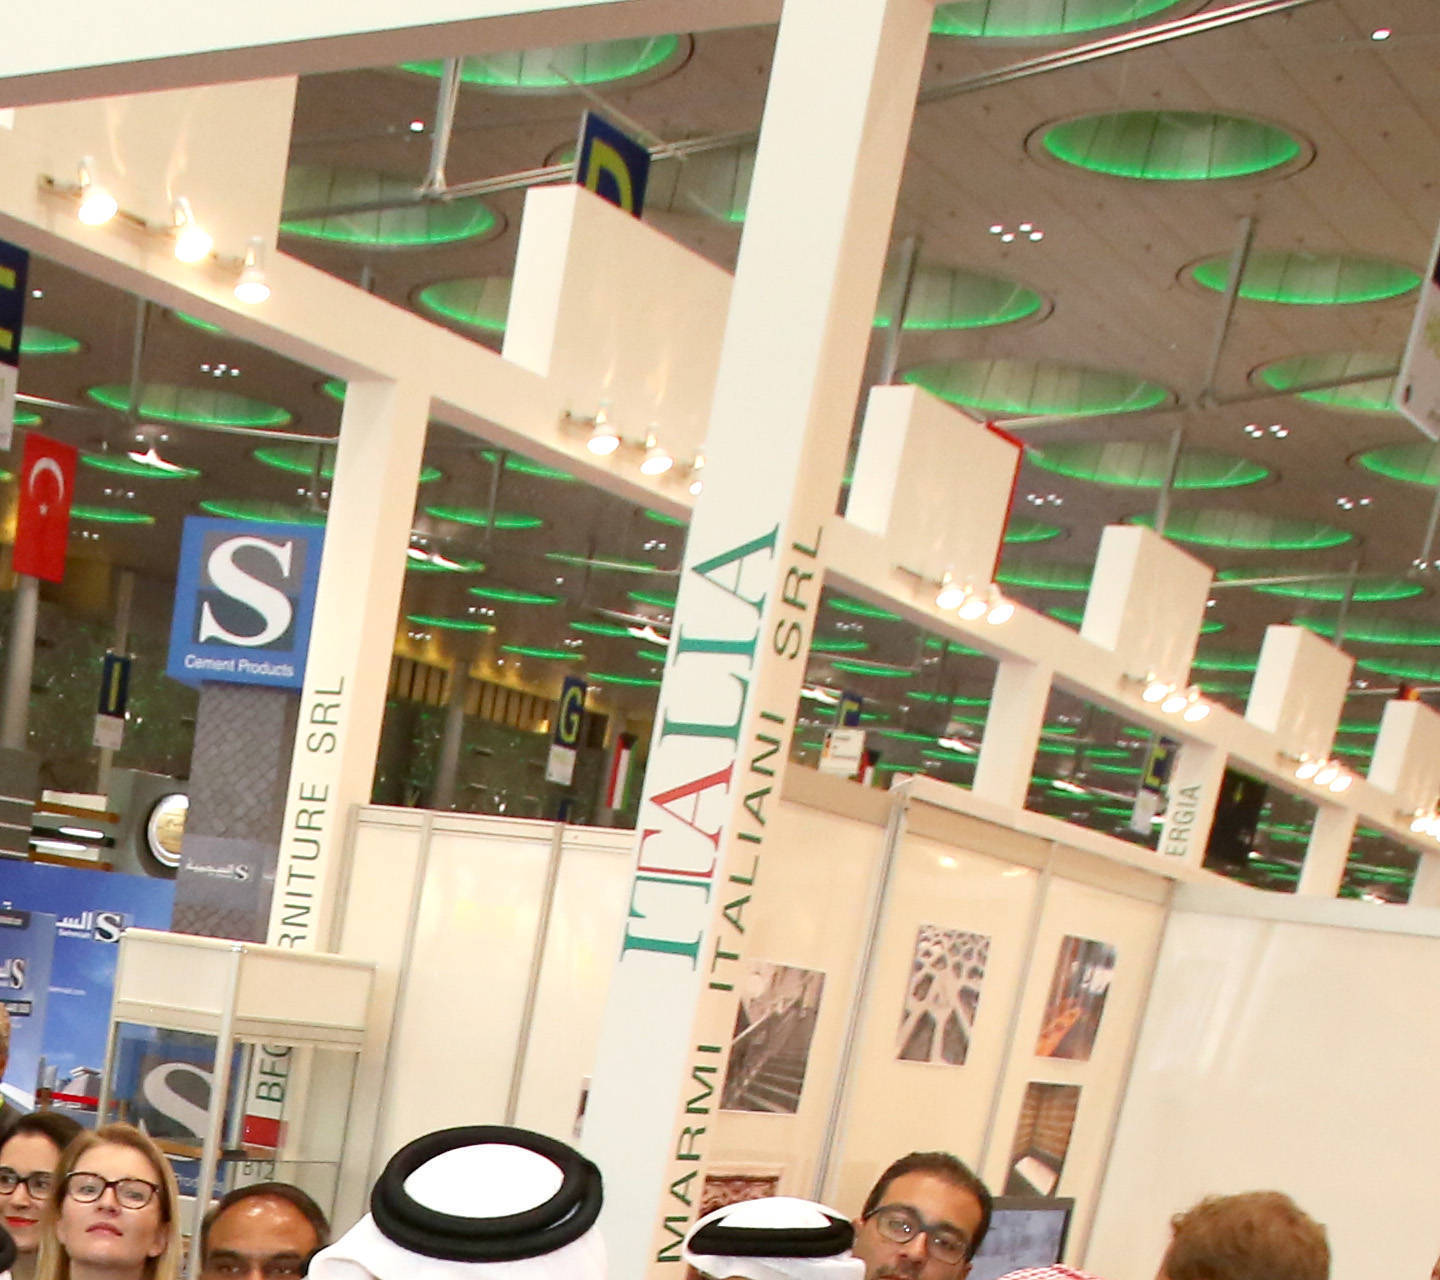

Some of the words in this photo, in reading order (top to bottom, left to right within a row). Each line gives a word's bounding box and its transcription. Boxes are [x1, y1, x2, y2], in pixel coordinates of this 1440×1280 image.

[199, 537, 294, 647] S
[184, 654, 235, 672] Cement
[237, 658, 295, 677] Products
[307, 676, 345, 754] SRL
[620, 523, 780, 971] ITALIA
[657, 1045, 722, 1263] MARMI
[709, 710, 786, 992] ITALIANI
[774, 526, 823, 660] SRL
